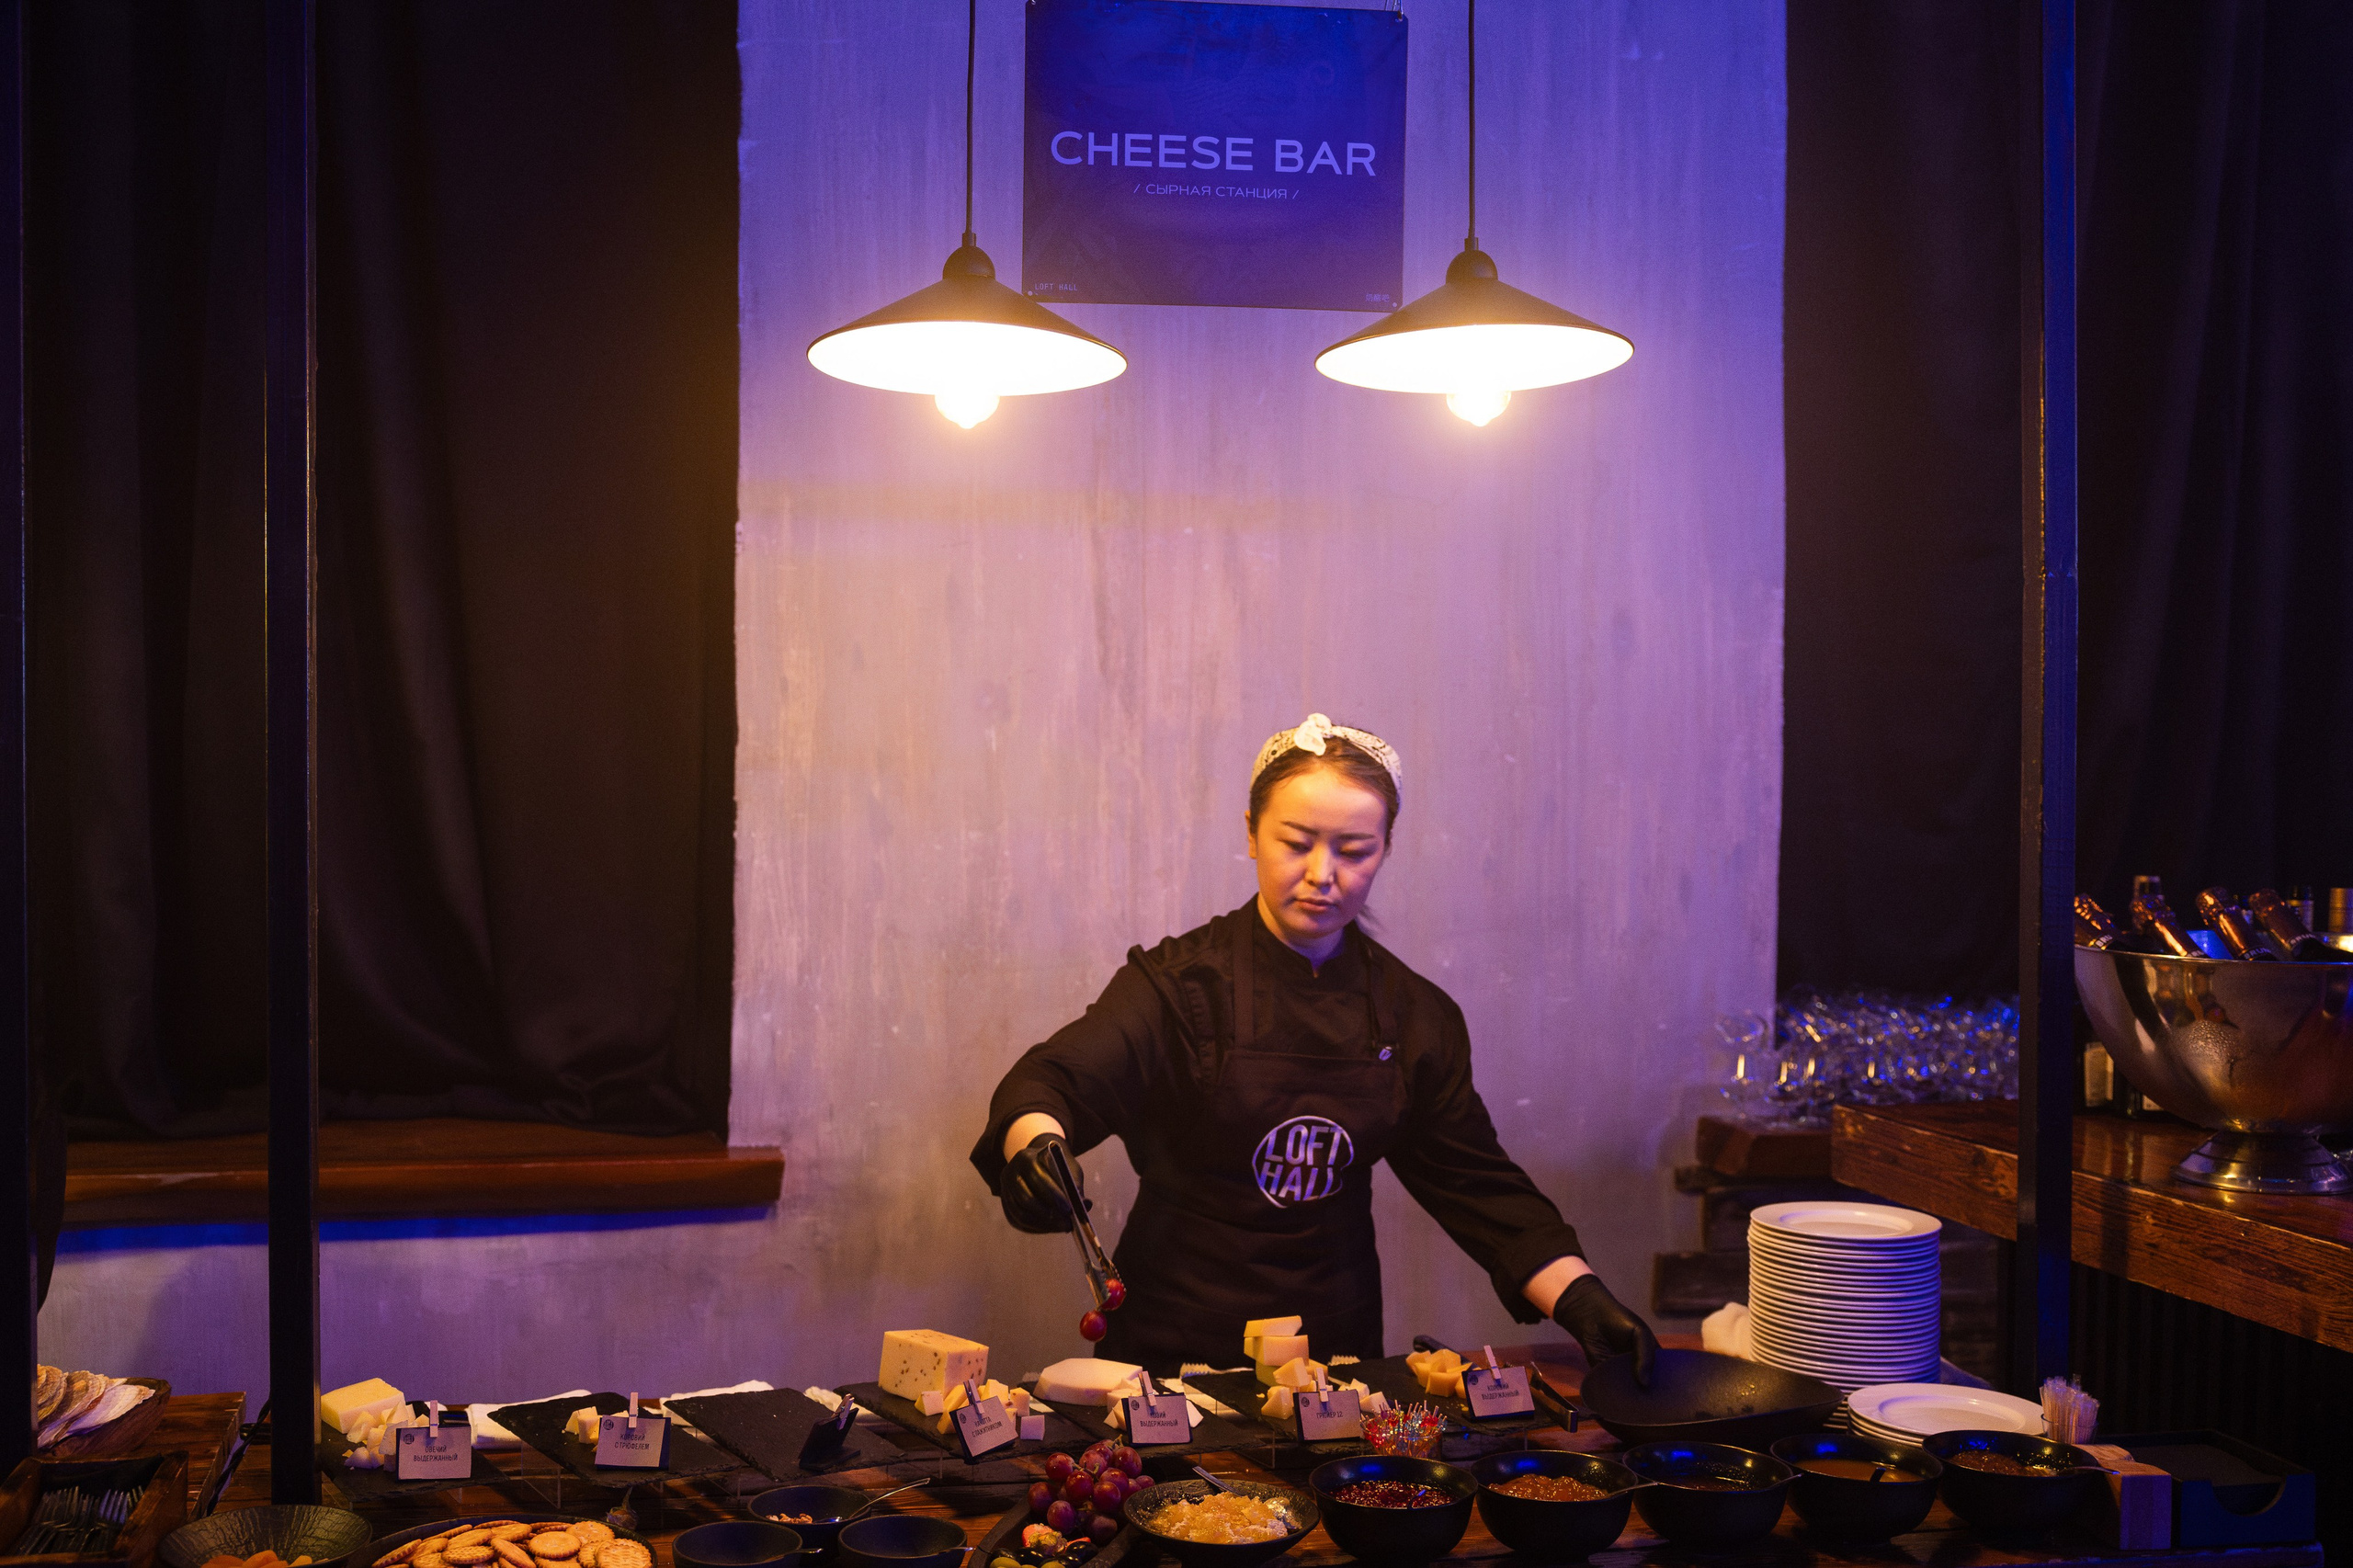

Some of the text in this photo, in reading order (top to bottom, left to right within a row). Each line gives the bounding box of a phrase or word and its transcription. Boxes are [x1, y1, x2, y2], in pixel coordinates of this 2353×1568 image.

[1051, 131, 1376, 176] CHEESE BAR
[1145, 184, 1211, 196] СЫРНАЯ
[1215, 186, 1287, 199] СТАНЦИЯ
[1034, 282, 1078, 291] LOFT HALL
[1264, 1123, 1343, 1165] LOFT
[620, 1433, 645, 1441] КОРОВИЙ
[425, 1444, 448, 1453] ОВЕЧИЙ
[413, 1452, 459, 1462] ВЫДЕРЖАННЫЙ
